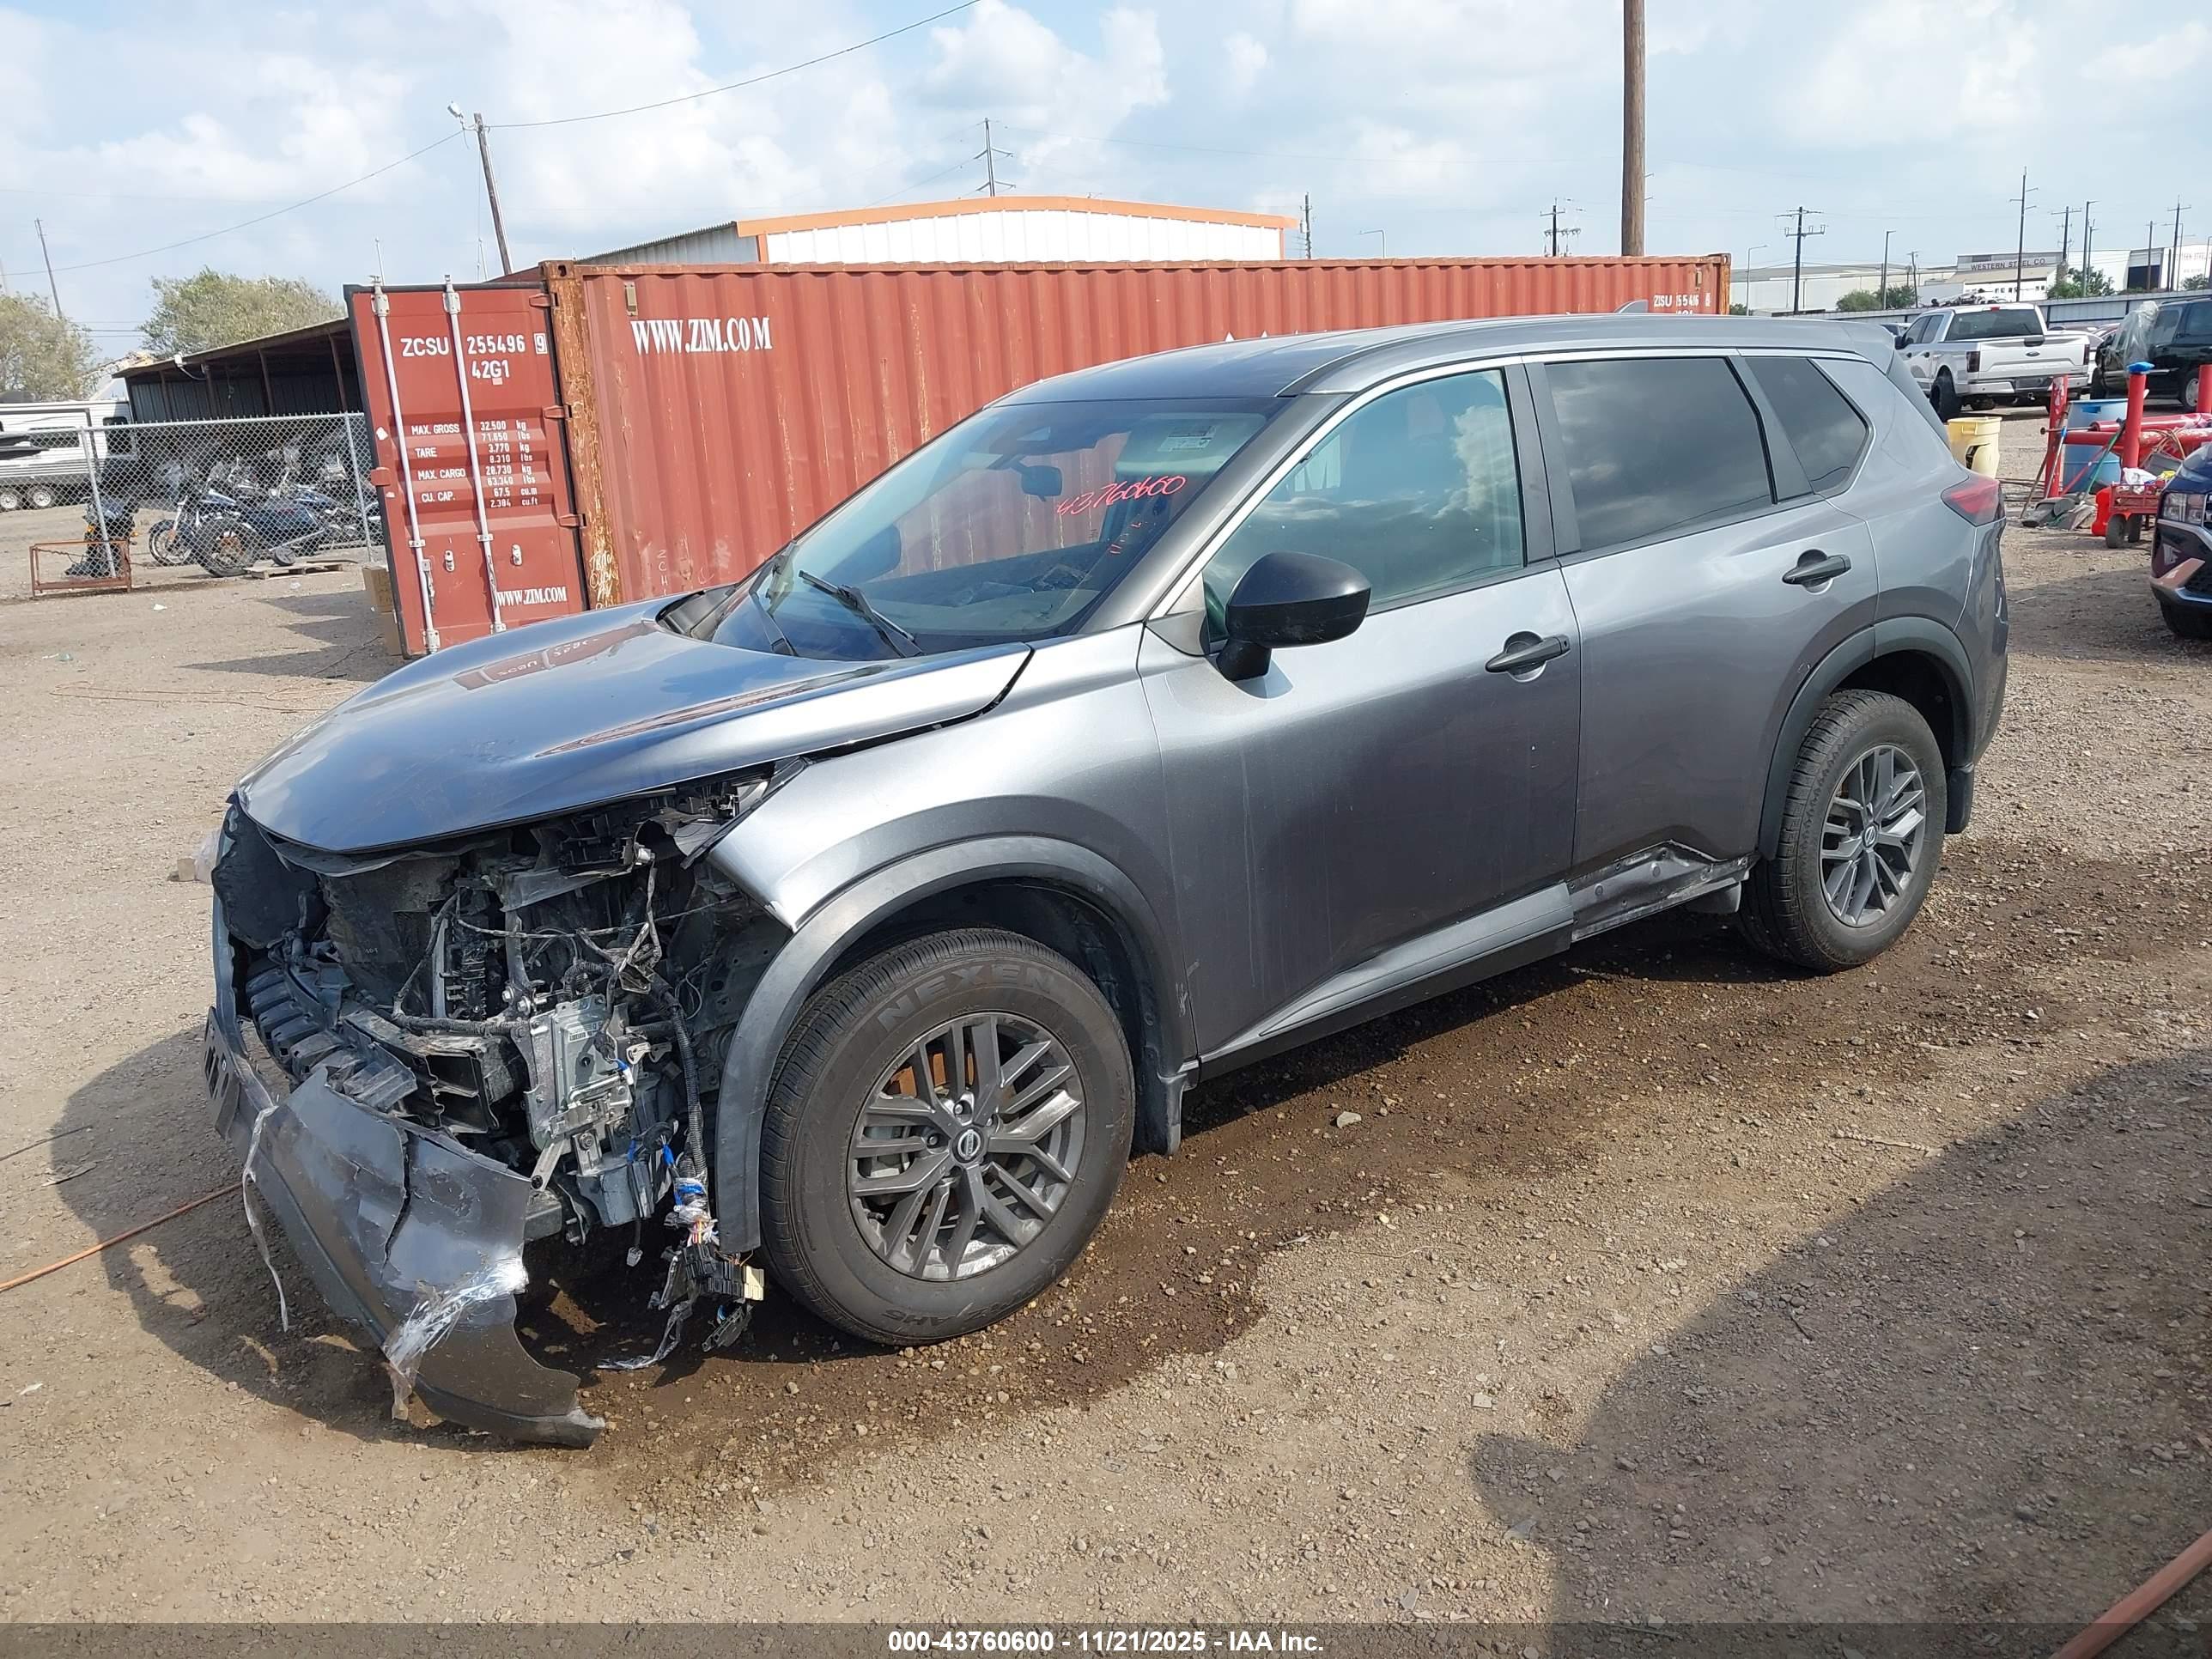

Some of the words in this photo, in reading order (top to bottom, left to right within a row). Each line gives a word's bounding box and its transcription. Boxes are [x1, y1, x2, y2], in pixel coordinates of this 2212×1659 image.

[1971, 262, 2005, 271] WESTERN
[2008, 260, 2031, 269] STEL
[629, 317, 773, 356] WWW.ZIM.COM
[400, 336, 450, 356] ZCSU
[466, 334, 526, 355] 255496
[535, 334, 547, 353] 9
[471, 359, 509, 379] 42G1
[411, 425, 431, 435] MAX.
[433, 423, 460, 434] GROSS
[480, 421, 507, 431] 32.500
[516, 420, 526, 431] kg
[482, 431, 508, 441] 71.650
[518, 431, 531, 441] lbs
[415, 447, 438, 458] TARE
[488, 443, 510, 453] 3.770
[520, 442, 530, 453] kg
[489, 454, 510, 464] 8.310
[520, 453, 533, 462] lbs
[417, 470, 437, 481] MAX.
[439, 468, 466, 479] CARGO
[485, 465, 512, 476] 28.730
[522, 465, 532, 476] kg
[487, 477, 514, 486] 63.340
[522, 475, 536, 484] lbs
[421, 492, 435, 502] CU.
[437, 491, 456, 501] CAP.
[493, 487, 511, 497] 67.5
[520, 486, 538, 495] cu.m
[1056, 475, 1187, 516] 43760600
[490, 499, 511, 508] 2.384
[521, 497, 538, 506] cu.ft
[496, 586, 567, 606] WWW.ZIM.COM
[877, 963, 1056, 1033] NEXEN
